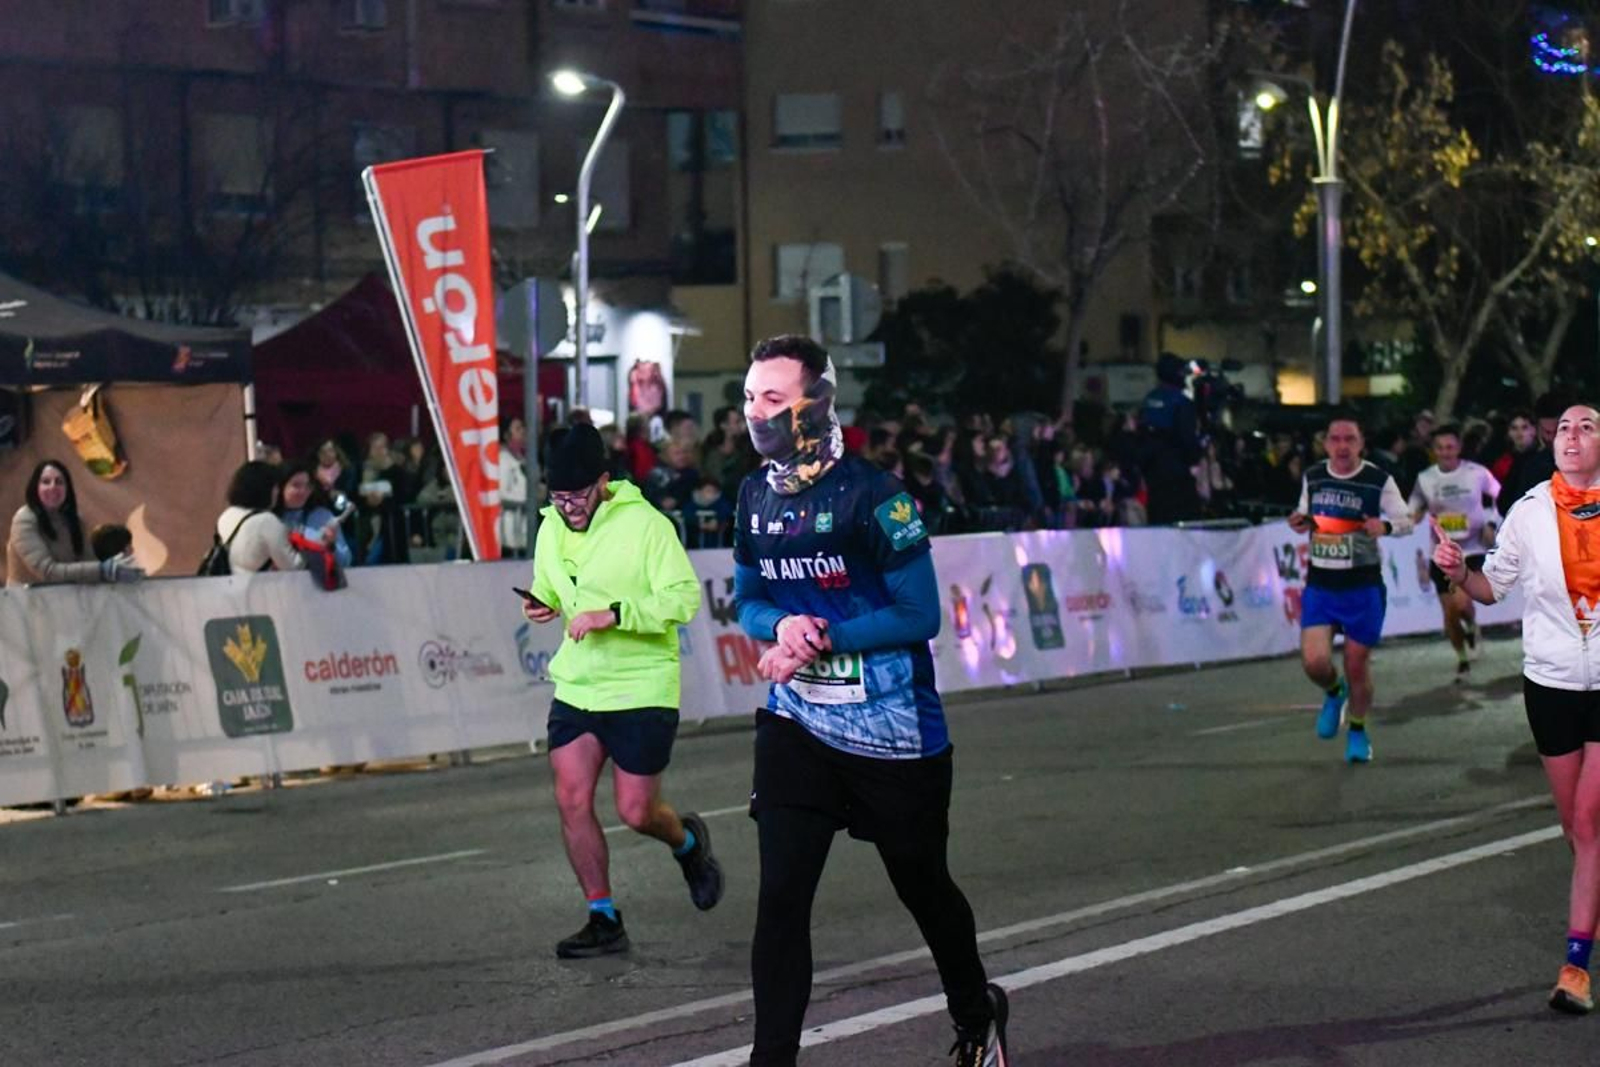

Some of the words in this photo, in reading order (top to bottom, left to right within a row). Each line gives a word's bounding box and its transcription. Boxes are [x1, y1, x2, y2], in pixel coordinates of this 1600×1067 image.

[416, 212, 501, 546] lderón
[780, 551, 846, 580] ANTÓN
[1312, 543, 1349, 558] 1703
[304, 648, 399, 682] calderón
